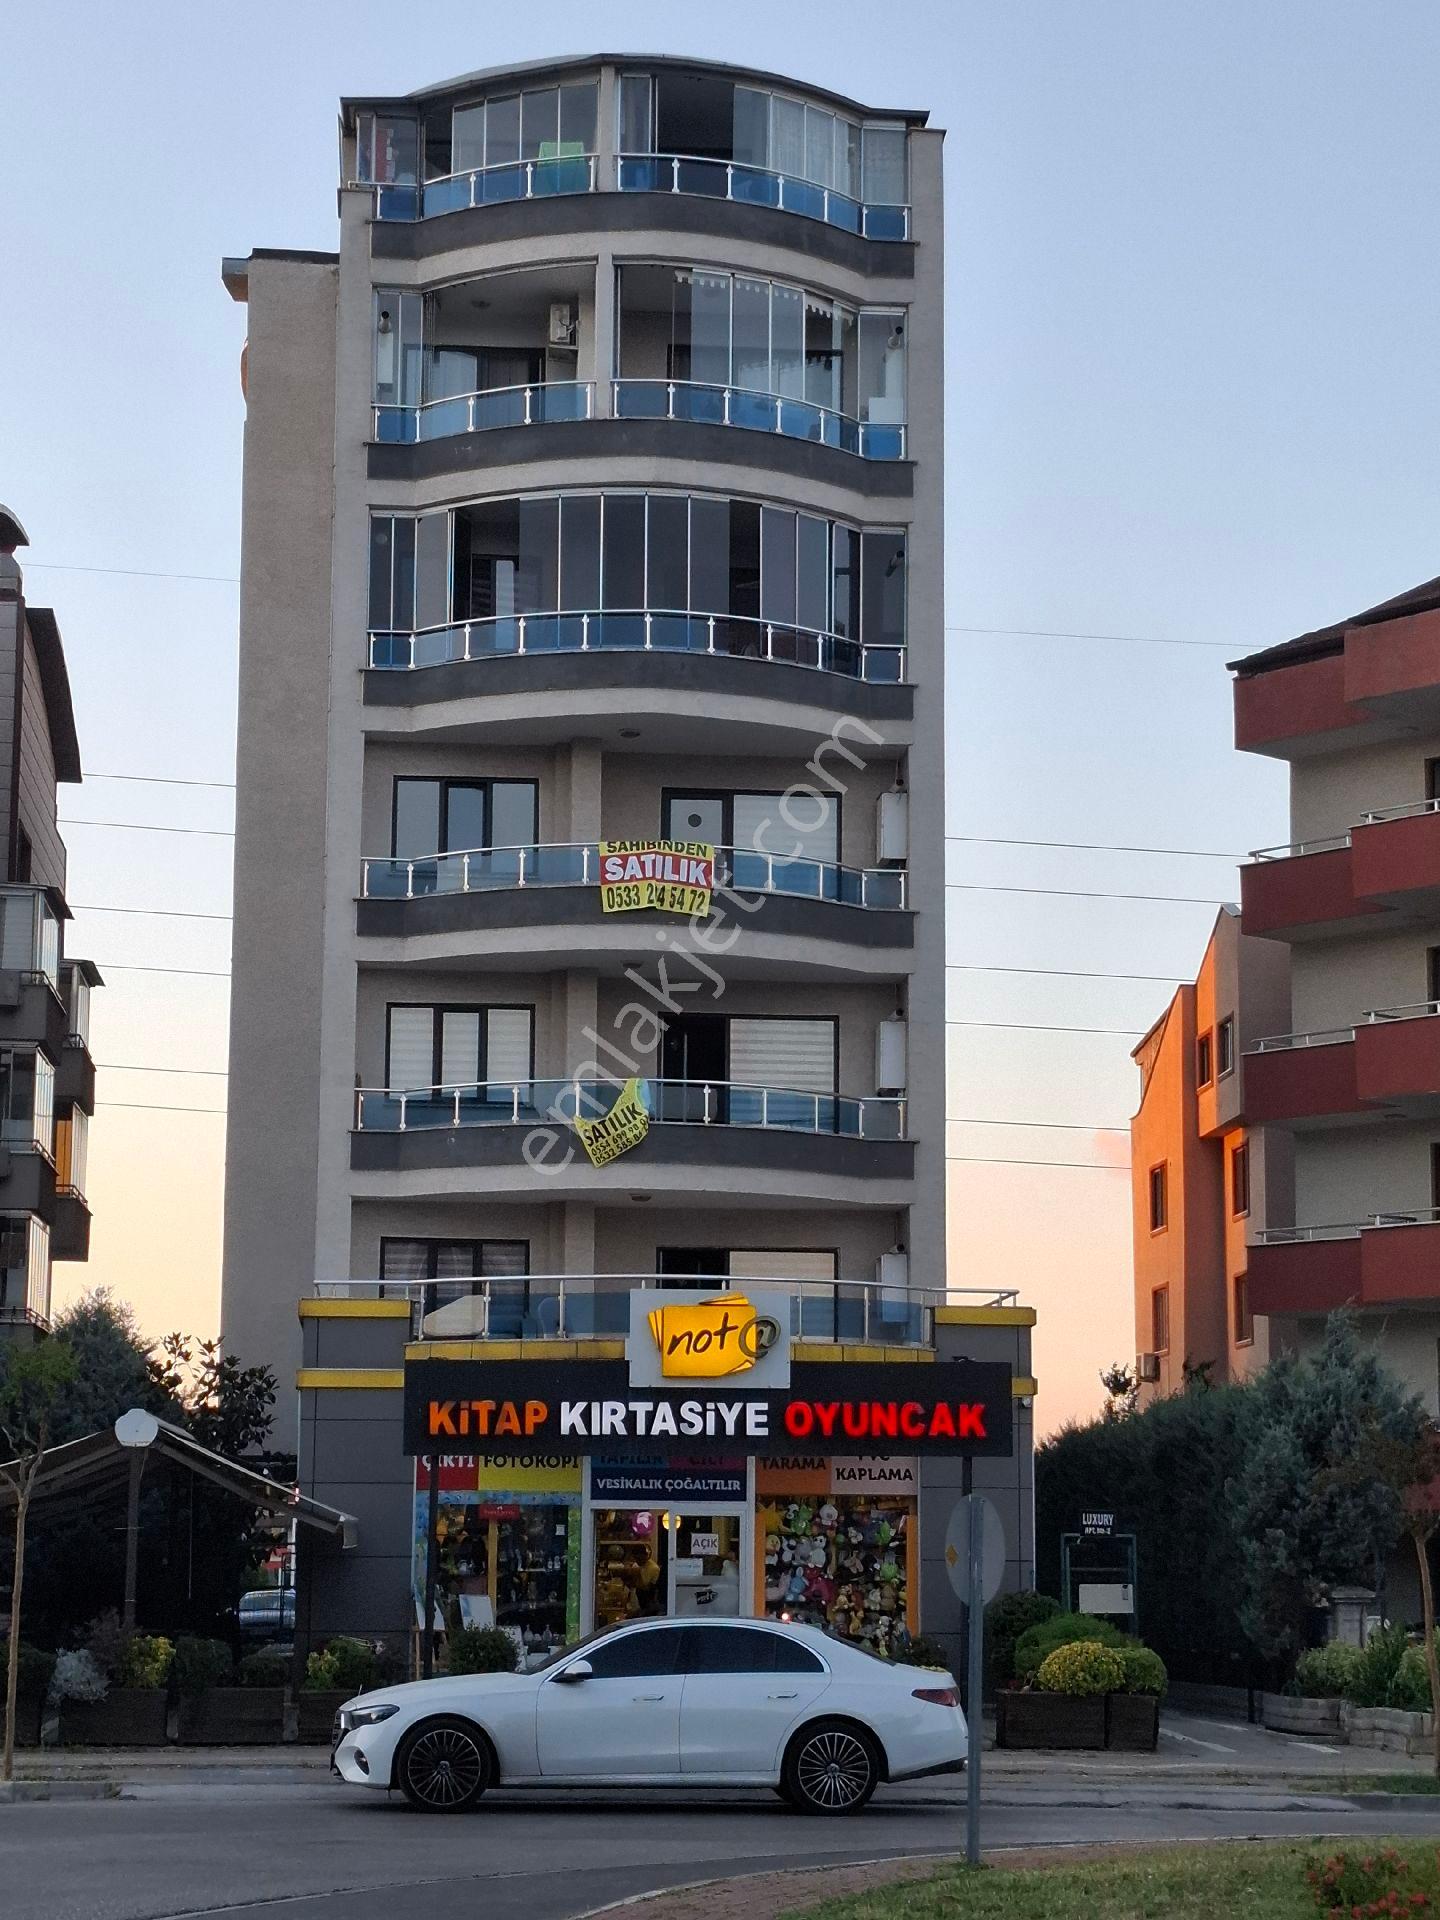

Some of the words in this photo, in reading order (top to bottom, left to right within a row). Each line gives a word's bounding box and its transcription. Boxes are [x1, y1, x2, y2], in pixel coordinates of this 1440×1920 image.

[605, 854, 707, 887] SATILIK
[606, 885, 640, 909] 0533
[669, 887, 684, 910] 54
[689, 889, 705, 912] 72
[583, 1103, 642, 1146] SATILIK
[784, 1400, 986, 1437] OYUNCAK
[760, 1457, 826, 1470] TARAMA
[836, 1468, 913, 1481] KAPLAMA
[1082, 1513, 1114, 1526] LUXURY
